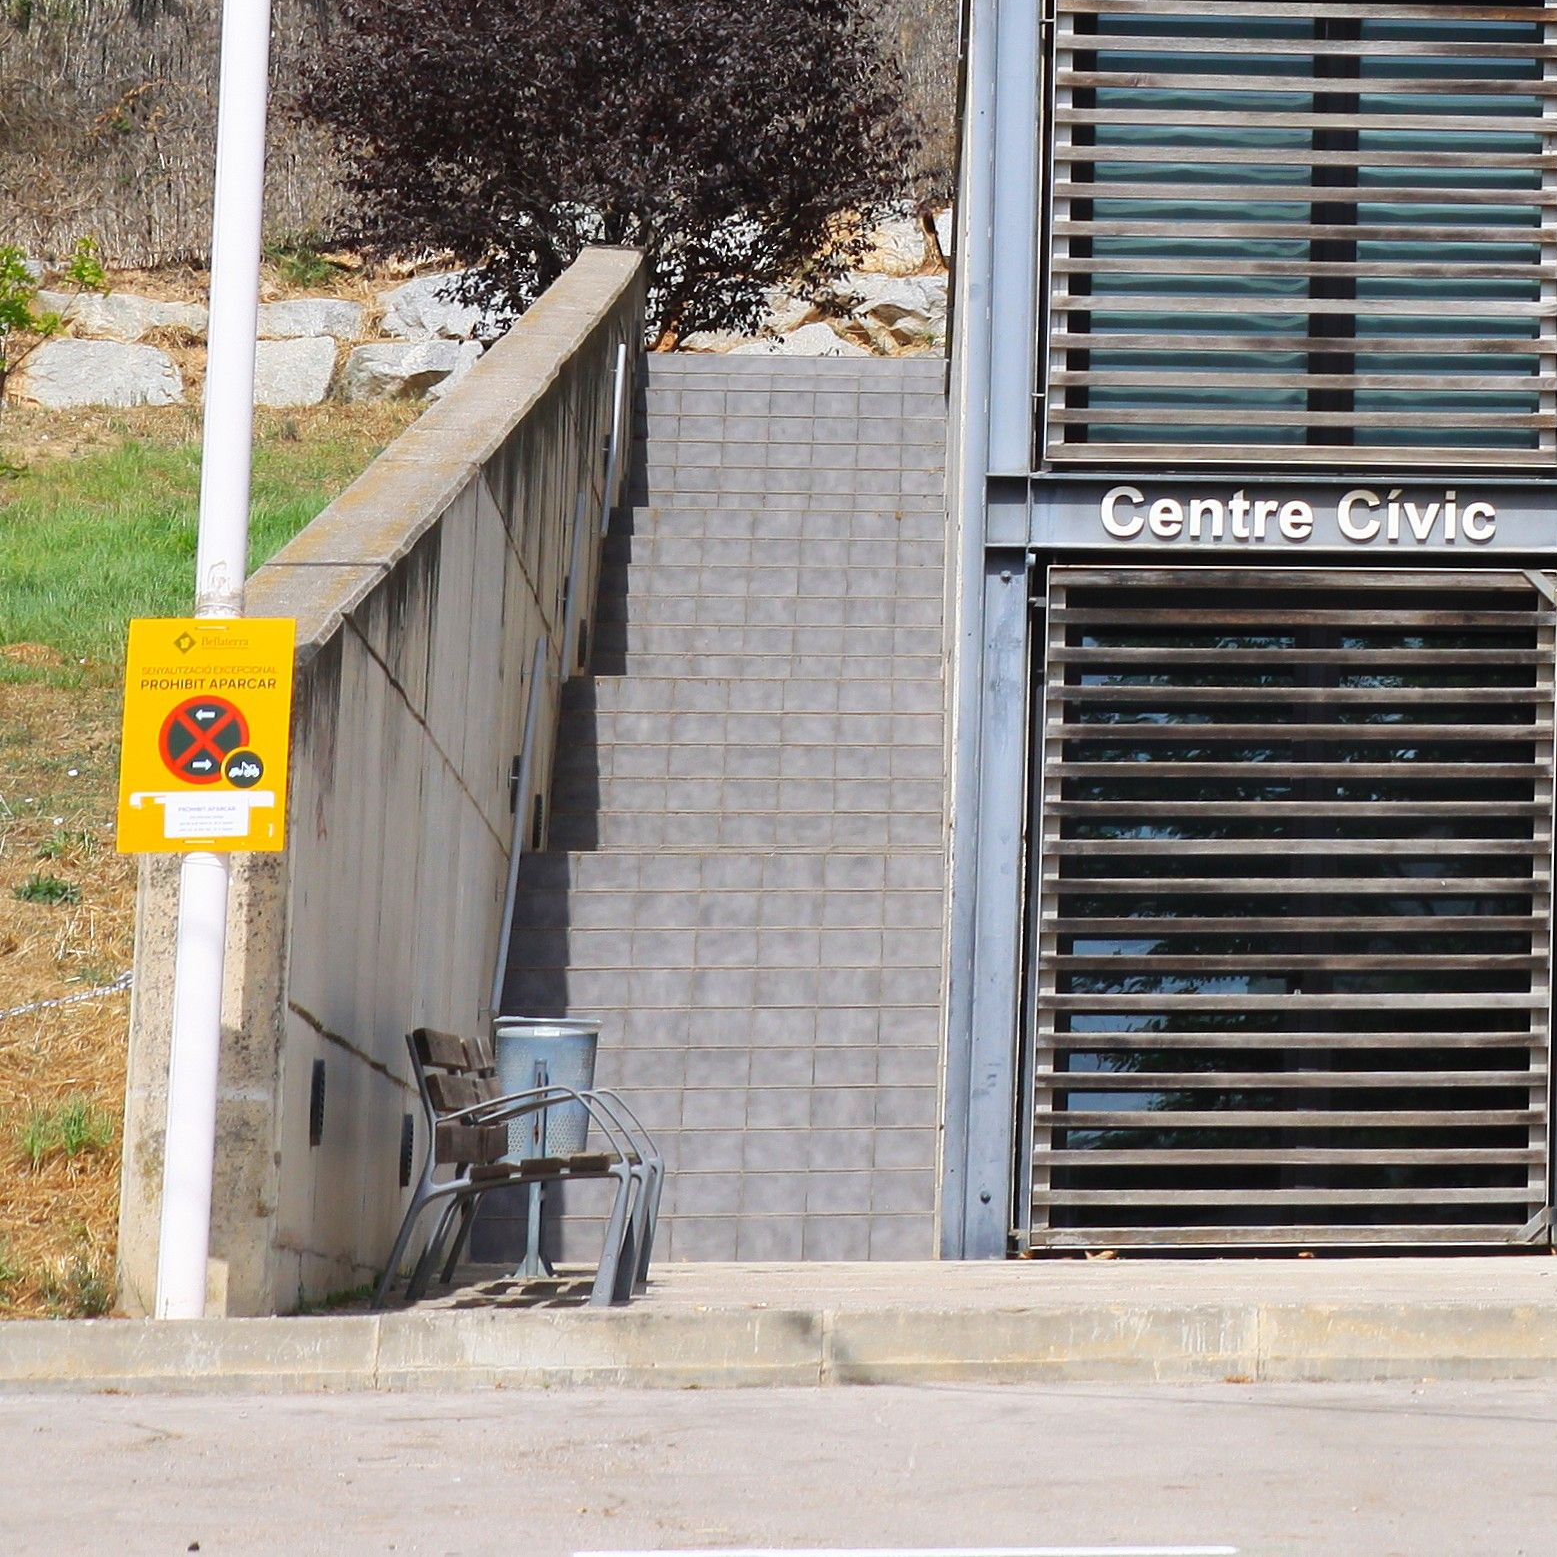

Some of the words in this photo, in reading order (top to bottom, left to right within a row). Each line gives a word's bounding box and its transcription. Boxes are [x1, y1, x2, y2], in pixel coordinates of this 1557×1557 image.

[1100, 485, 1315, 540] Centre
[1336, 488, 1498, 543] Cívic
[200, 636, 249, 647] Bellaterra
[140, 678, 206, 690] PROHIBIT
[209, 678, 277, 689] APARCAR
